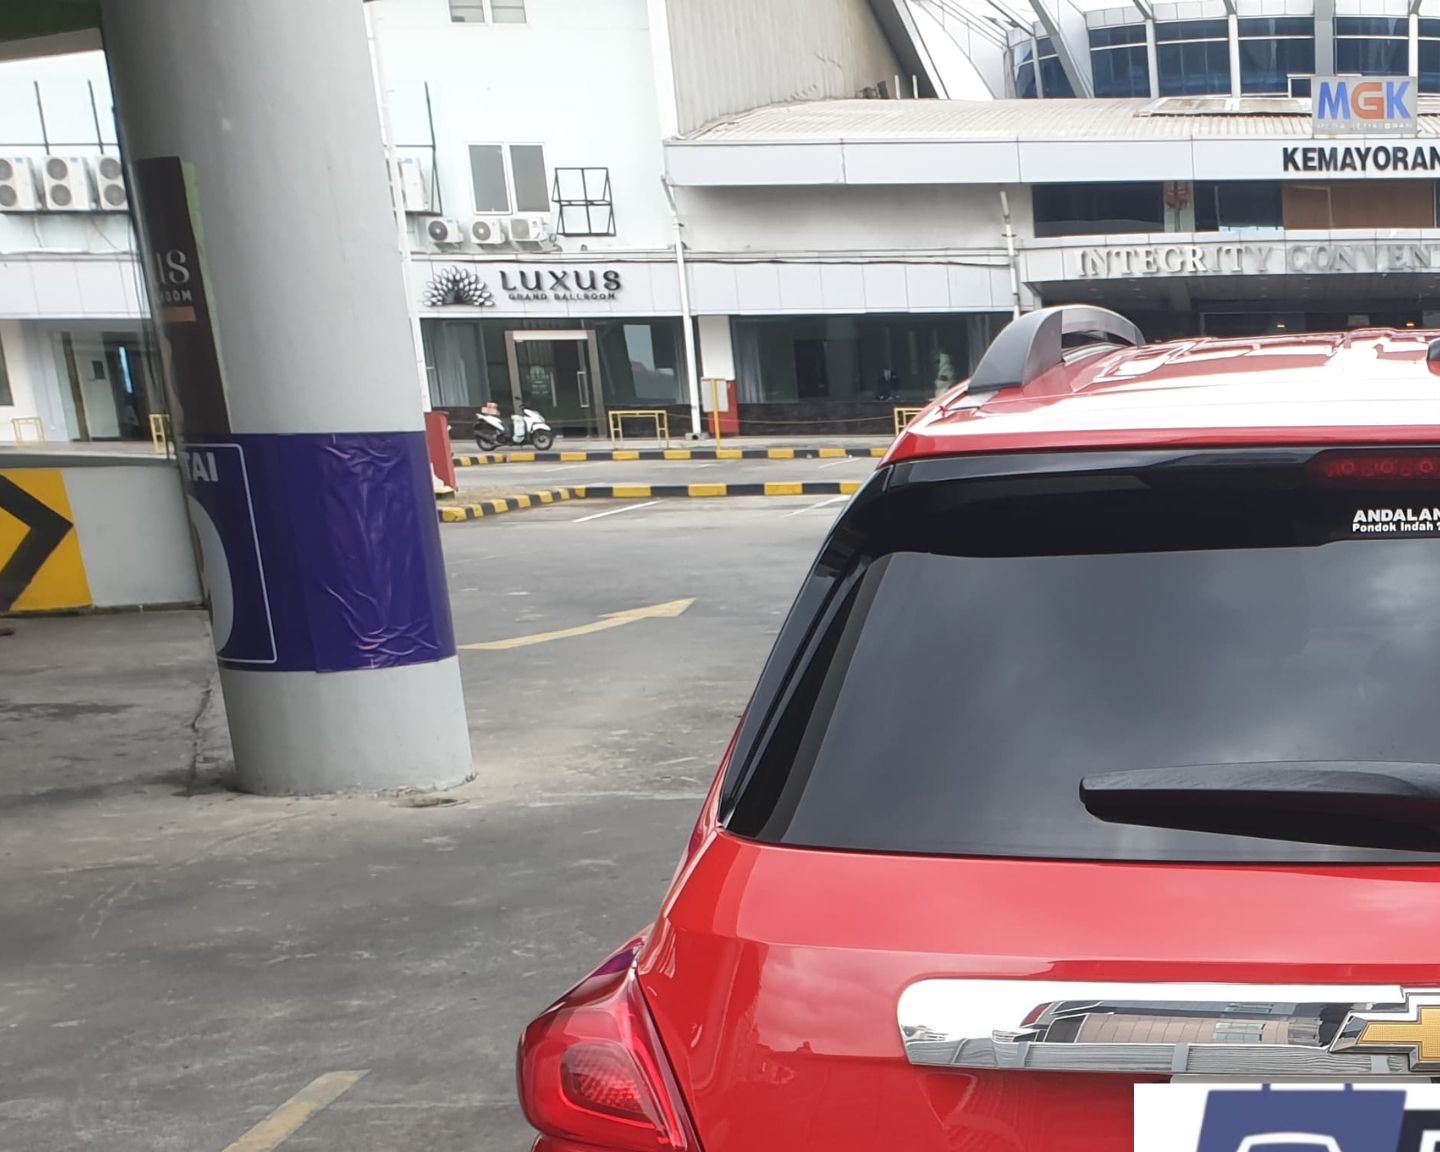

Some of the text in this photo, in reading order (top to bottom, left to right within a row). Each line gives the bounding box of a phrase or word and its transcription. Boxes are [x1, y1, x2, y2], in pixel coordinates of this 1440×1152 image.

[1317, 81, 1412, 121] MGK
[1078, 246, 1271, 277] INTEGRITY
[499, 269, 622, 291] LUXUS
[508, 292, 617, 301] GRAND BALLROOM
[1352, 522, 1397, 532] Pondok
[1400, 521, 1434, 532] Indah
